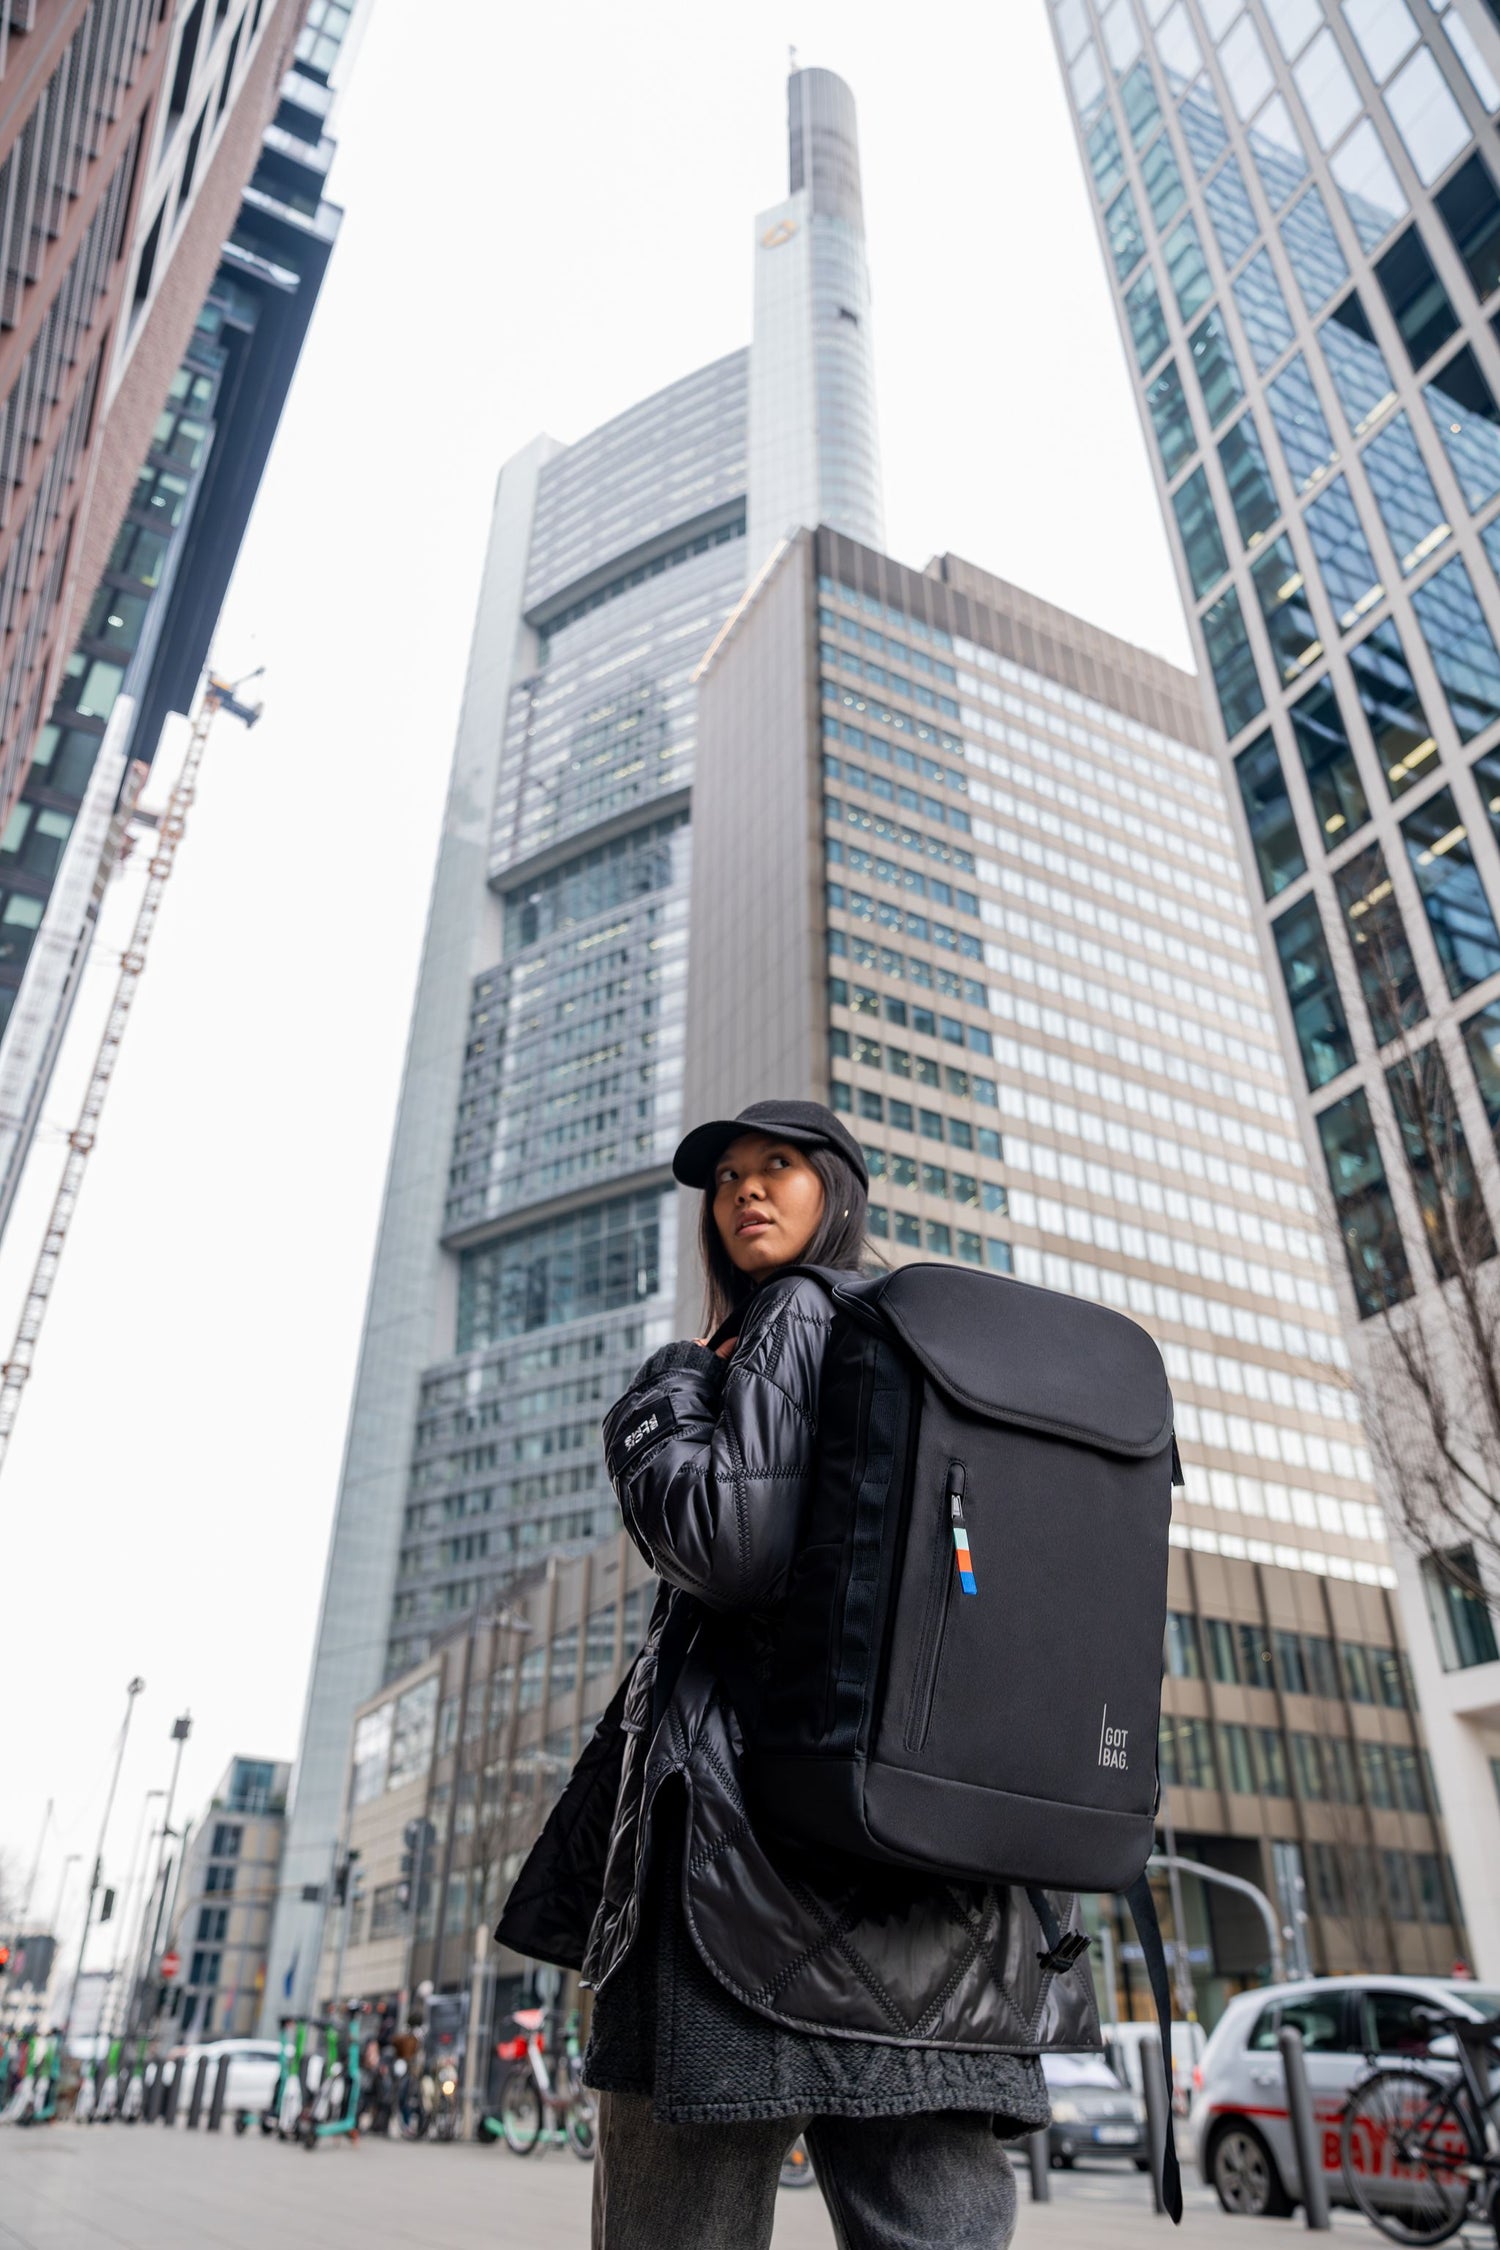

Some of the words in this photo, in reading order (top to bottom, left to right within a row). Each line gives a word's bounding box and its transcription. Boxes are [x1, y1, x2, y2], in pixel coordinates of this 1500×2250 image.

[624, 1413, 657, 1447] PLMS
[627, 1421, 659, 1453] BLCK
[1105, 1727, 1129, 1748] GOT
